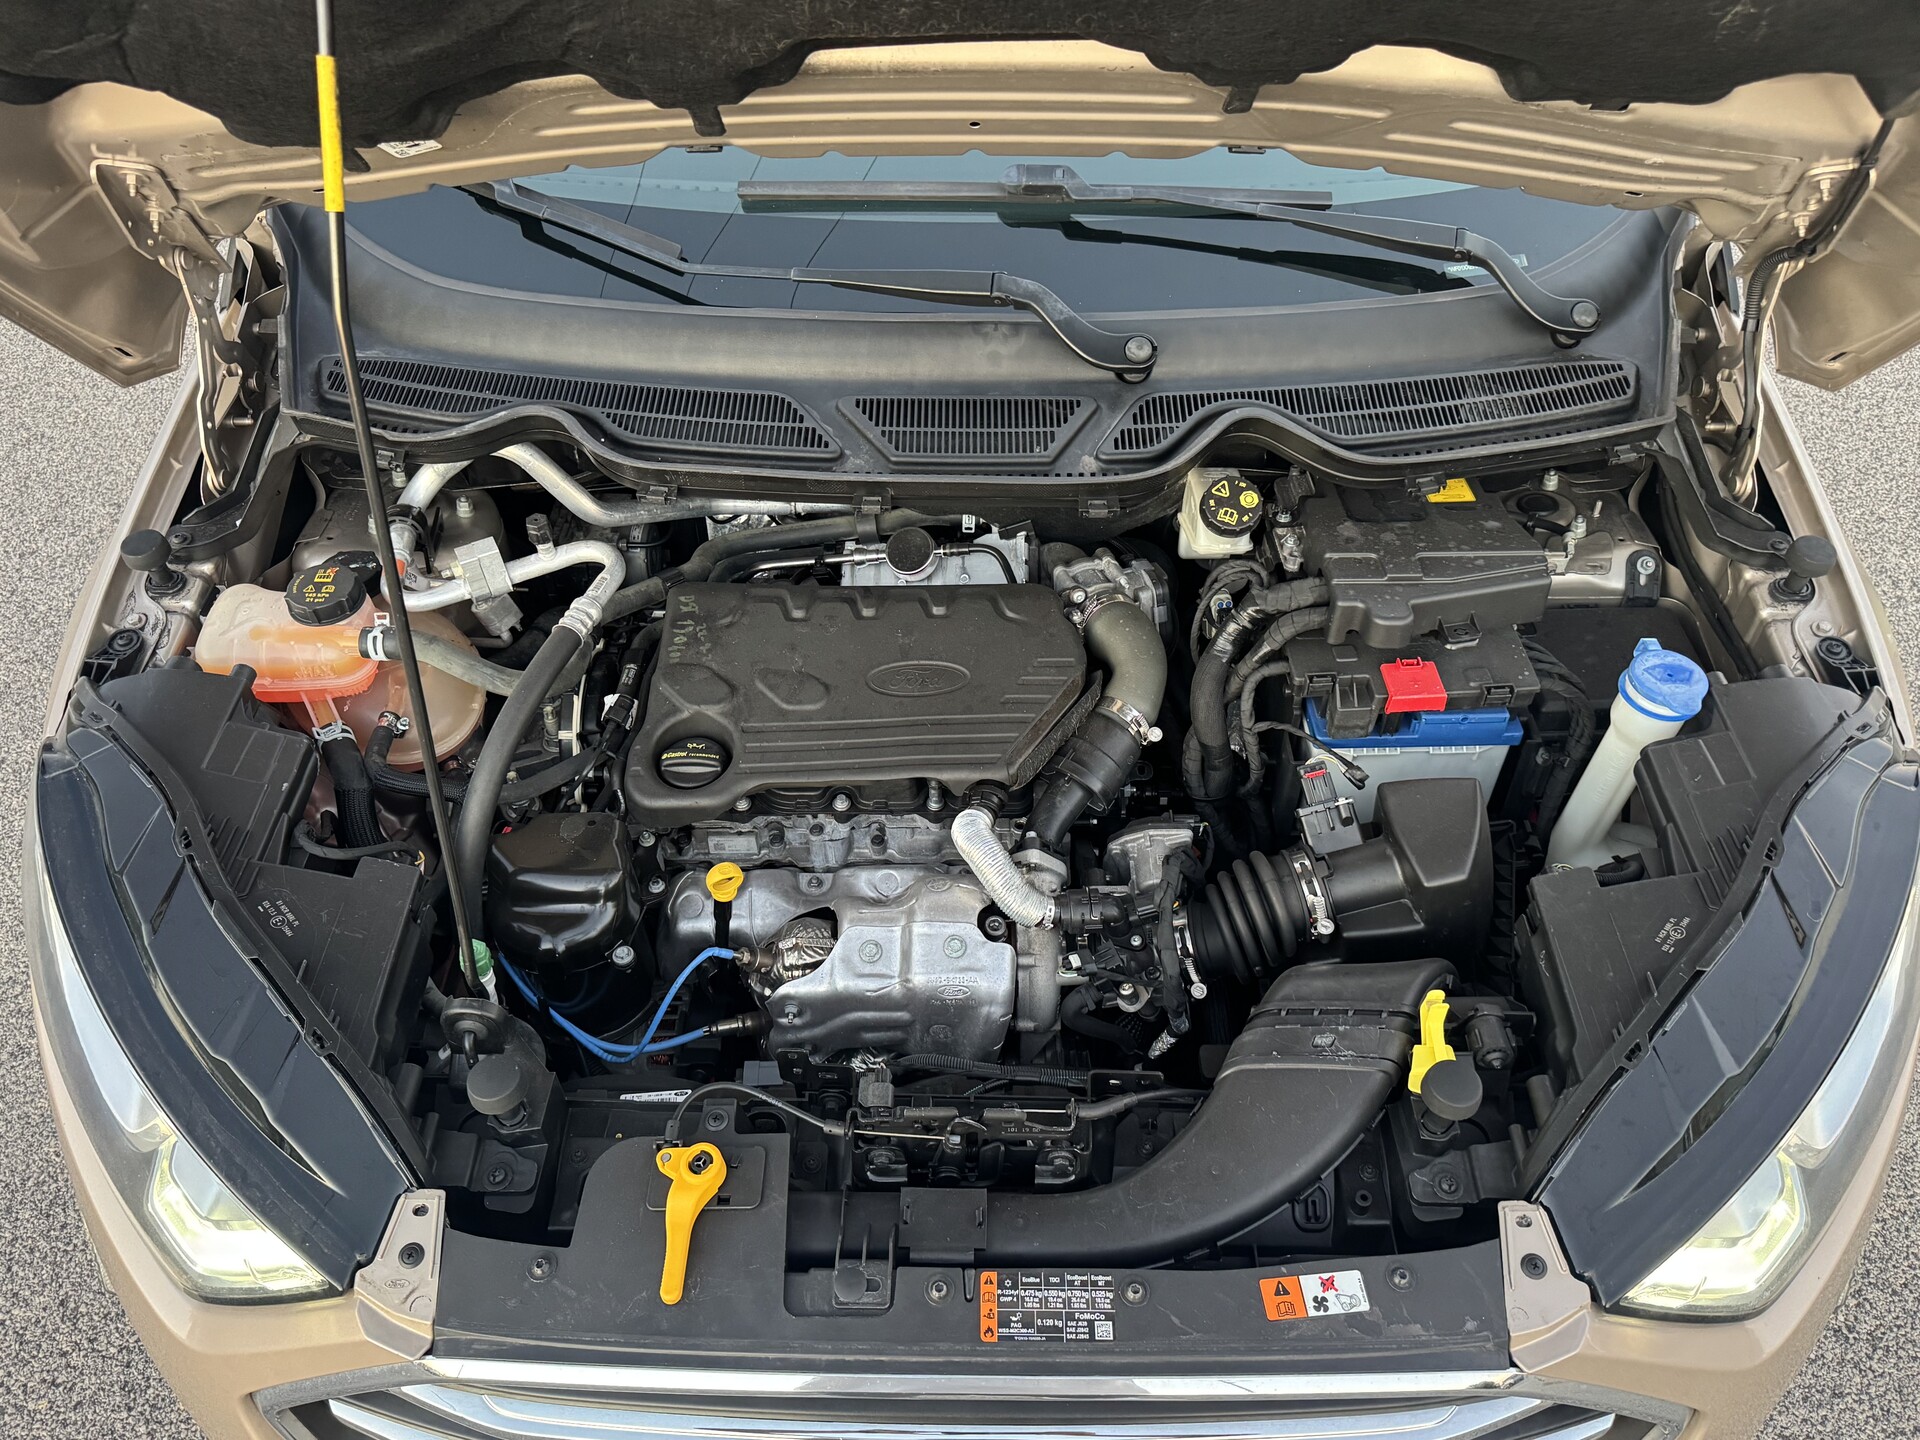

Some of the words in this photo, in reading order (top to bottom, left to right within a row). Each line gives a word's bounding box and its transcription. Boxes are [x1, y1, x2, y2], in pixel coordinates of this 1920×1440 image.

[889, 669, 945, 689] Ford
[1035, 1290, 1043, 1298] kg
[1058, 1290, 1066, 1299] kg
[1081, 1290, 1089, 1299] kg
[1091, 1290, 1105, 1298] 0.525
[1105, 1291, 1114, 1299] kg
[1074, 1312, 1106, 1320] FoMoCo
[1037, 1318, 1053, 1326] 0.120
[1054, 1318, 1063, 1328] kg
